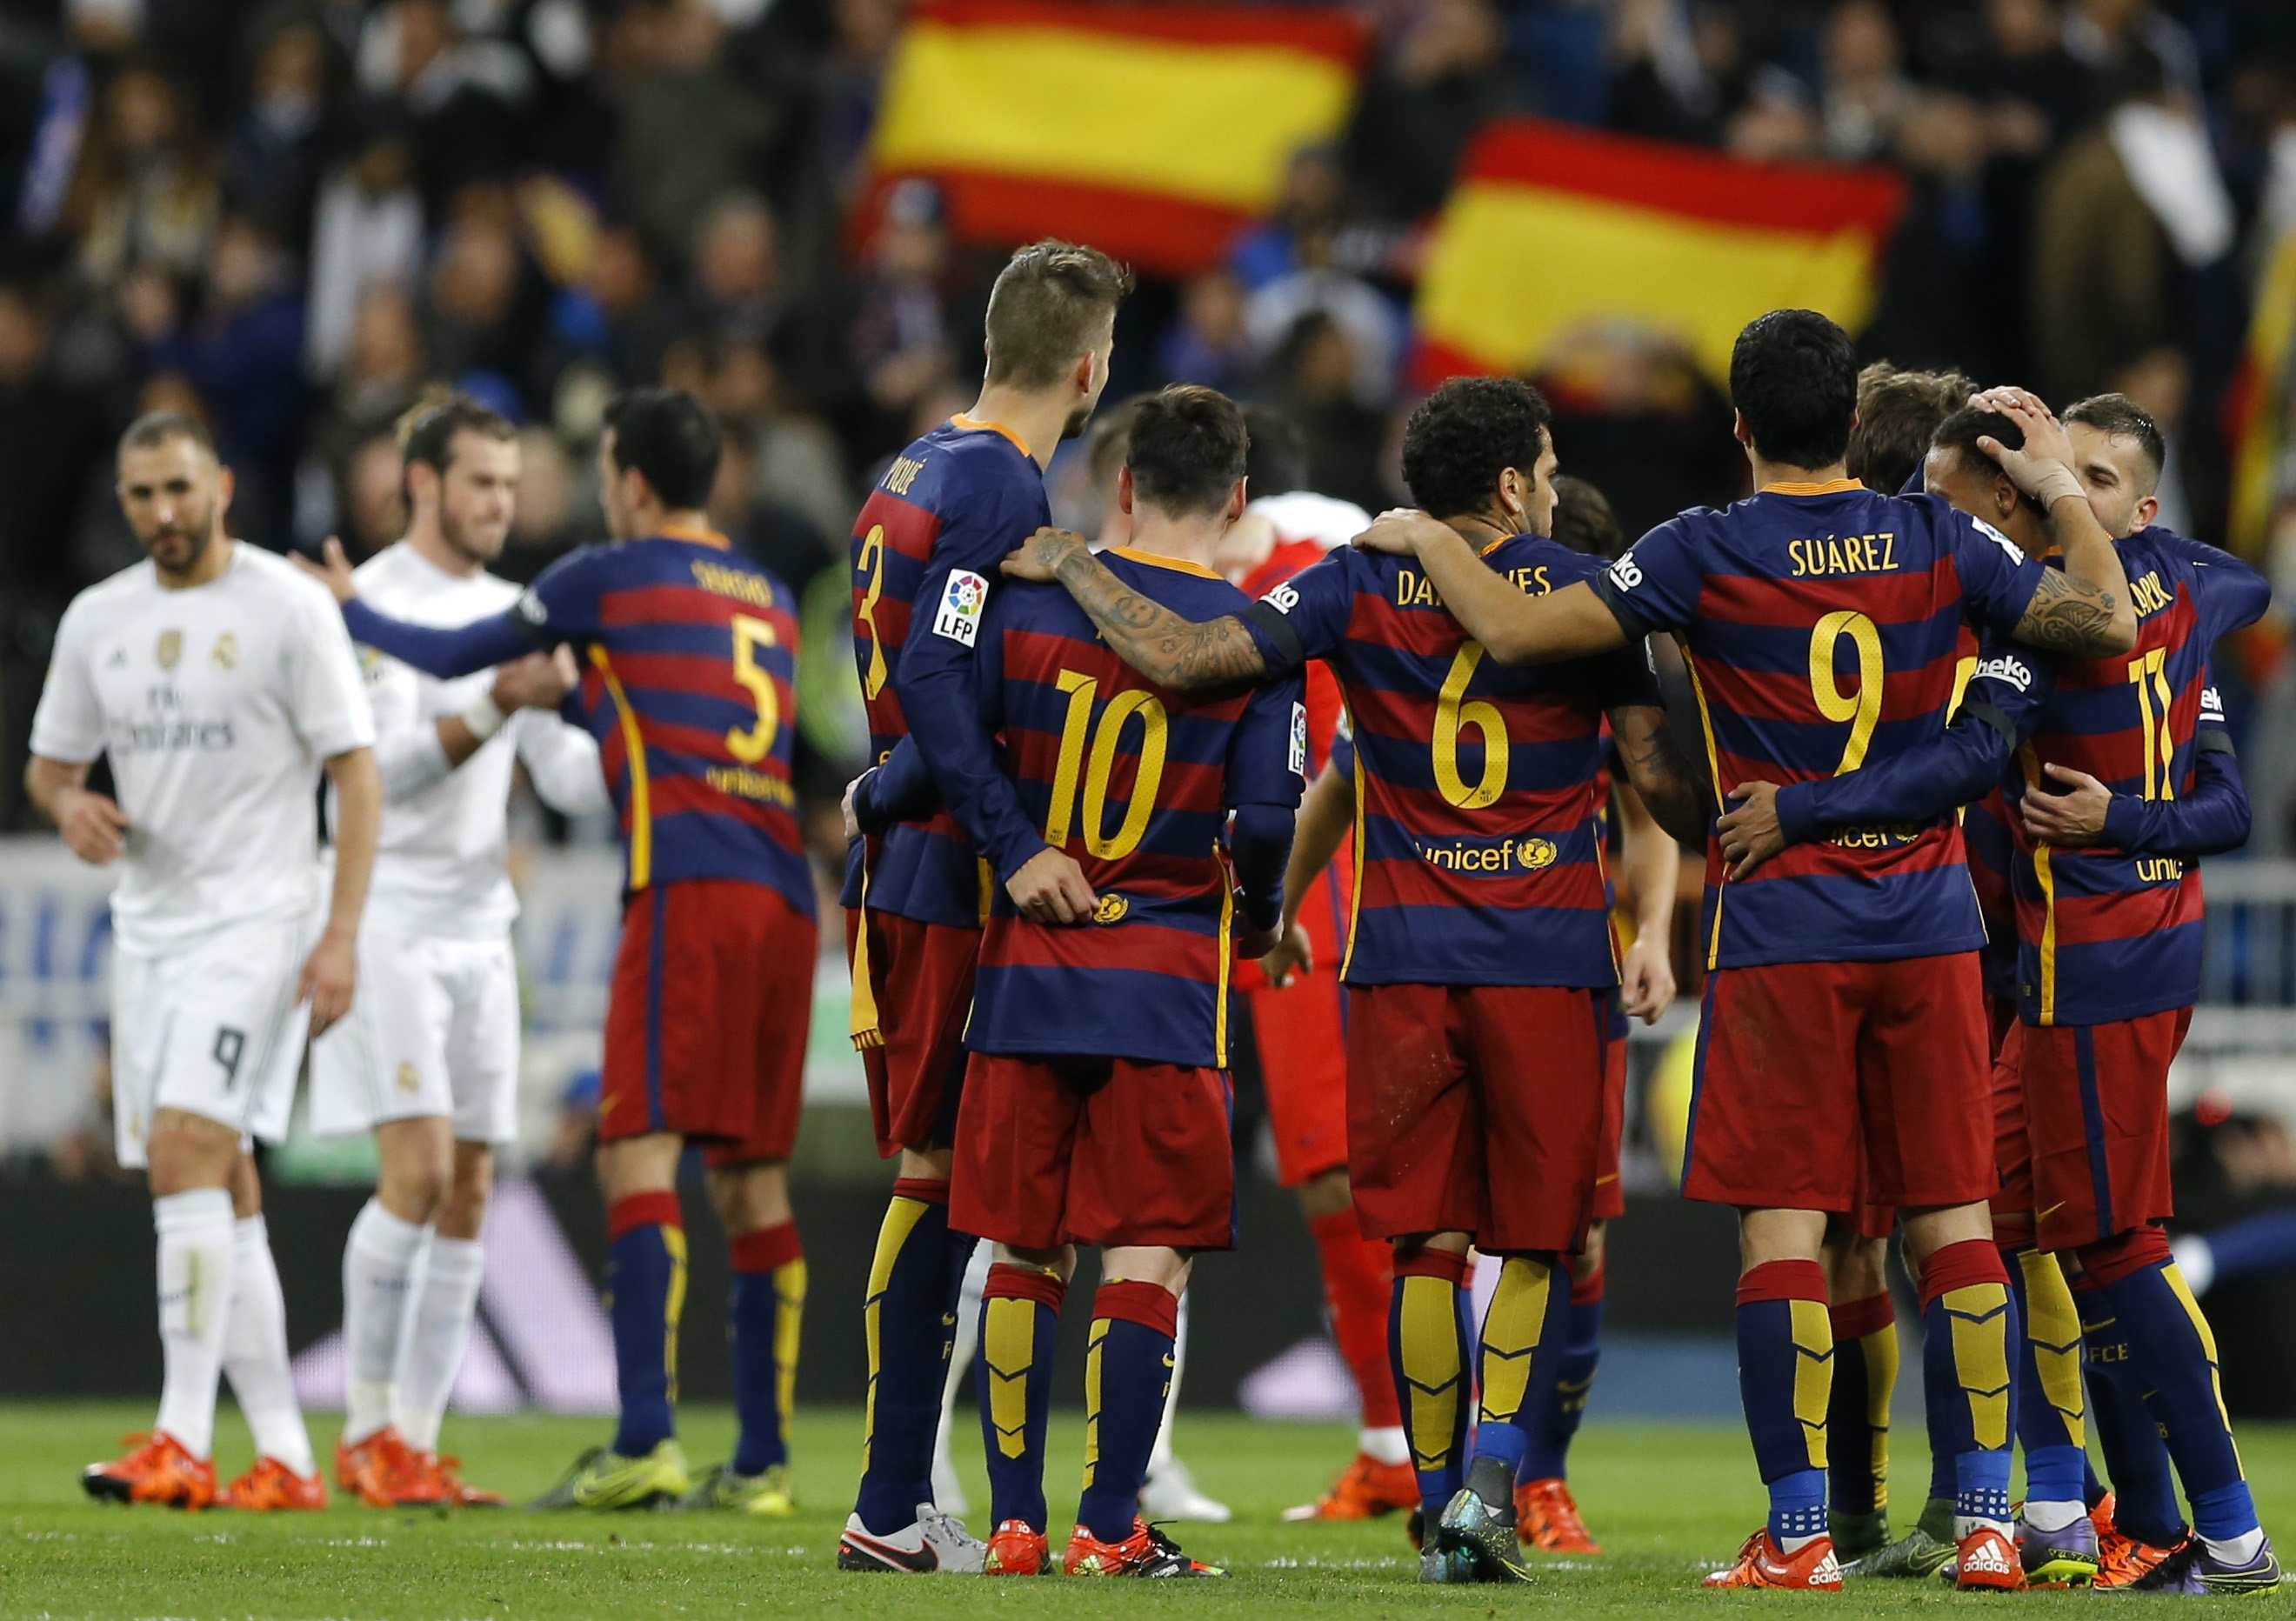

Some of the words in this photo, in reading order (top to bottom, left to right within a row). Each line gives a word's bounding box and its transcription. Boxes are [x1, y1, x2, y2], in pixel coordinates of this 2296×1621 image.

[880, 457, 928, 496] PIQUÉ
[1788, 532, 1899, 577] SUÁREZ
[858, 524, 888, 701] 3
[940, 614, 973, 640] LFP
[727, 613, 778, 763] 5
[1431, 640, 1510, 810] 6
[1809, 610, 1886, 778] 9
[2128, 646, 2174, 802] 11
[1045, 668, 1169, 861] 10
[214, 1024, 246, 1088] 9
[1017, 1524, 1031, 1534] 10
[1963, 1558, 2010, 1575] adidas
